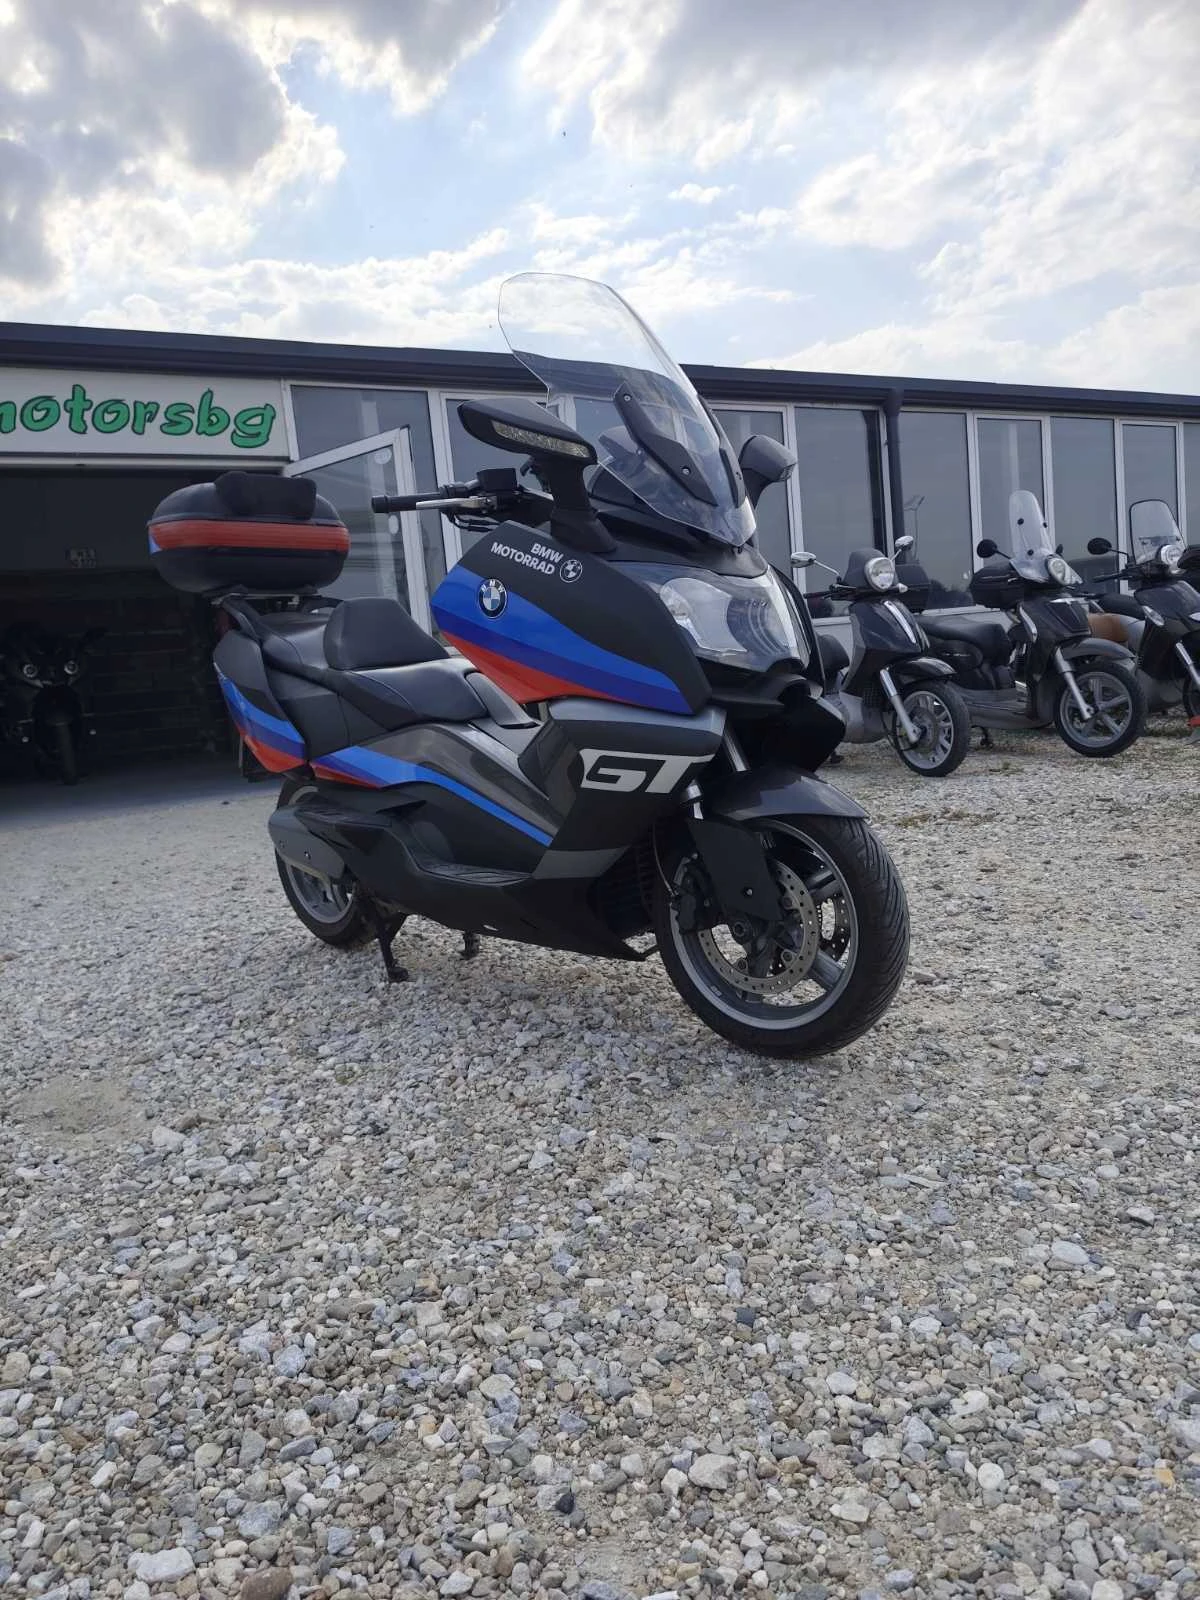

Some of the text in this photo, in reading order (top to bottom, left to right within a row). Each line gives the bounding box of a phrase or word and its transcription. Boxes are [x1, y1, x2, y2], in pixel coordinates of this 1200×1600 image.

[490, 542, 556, 575] MOTORRAD
[530, 543, 564, 564] BMW
[579, 748, 716, 794] GT
